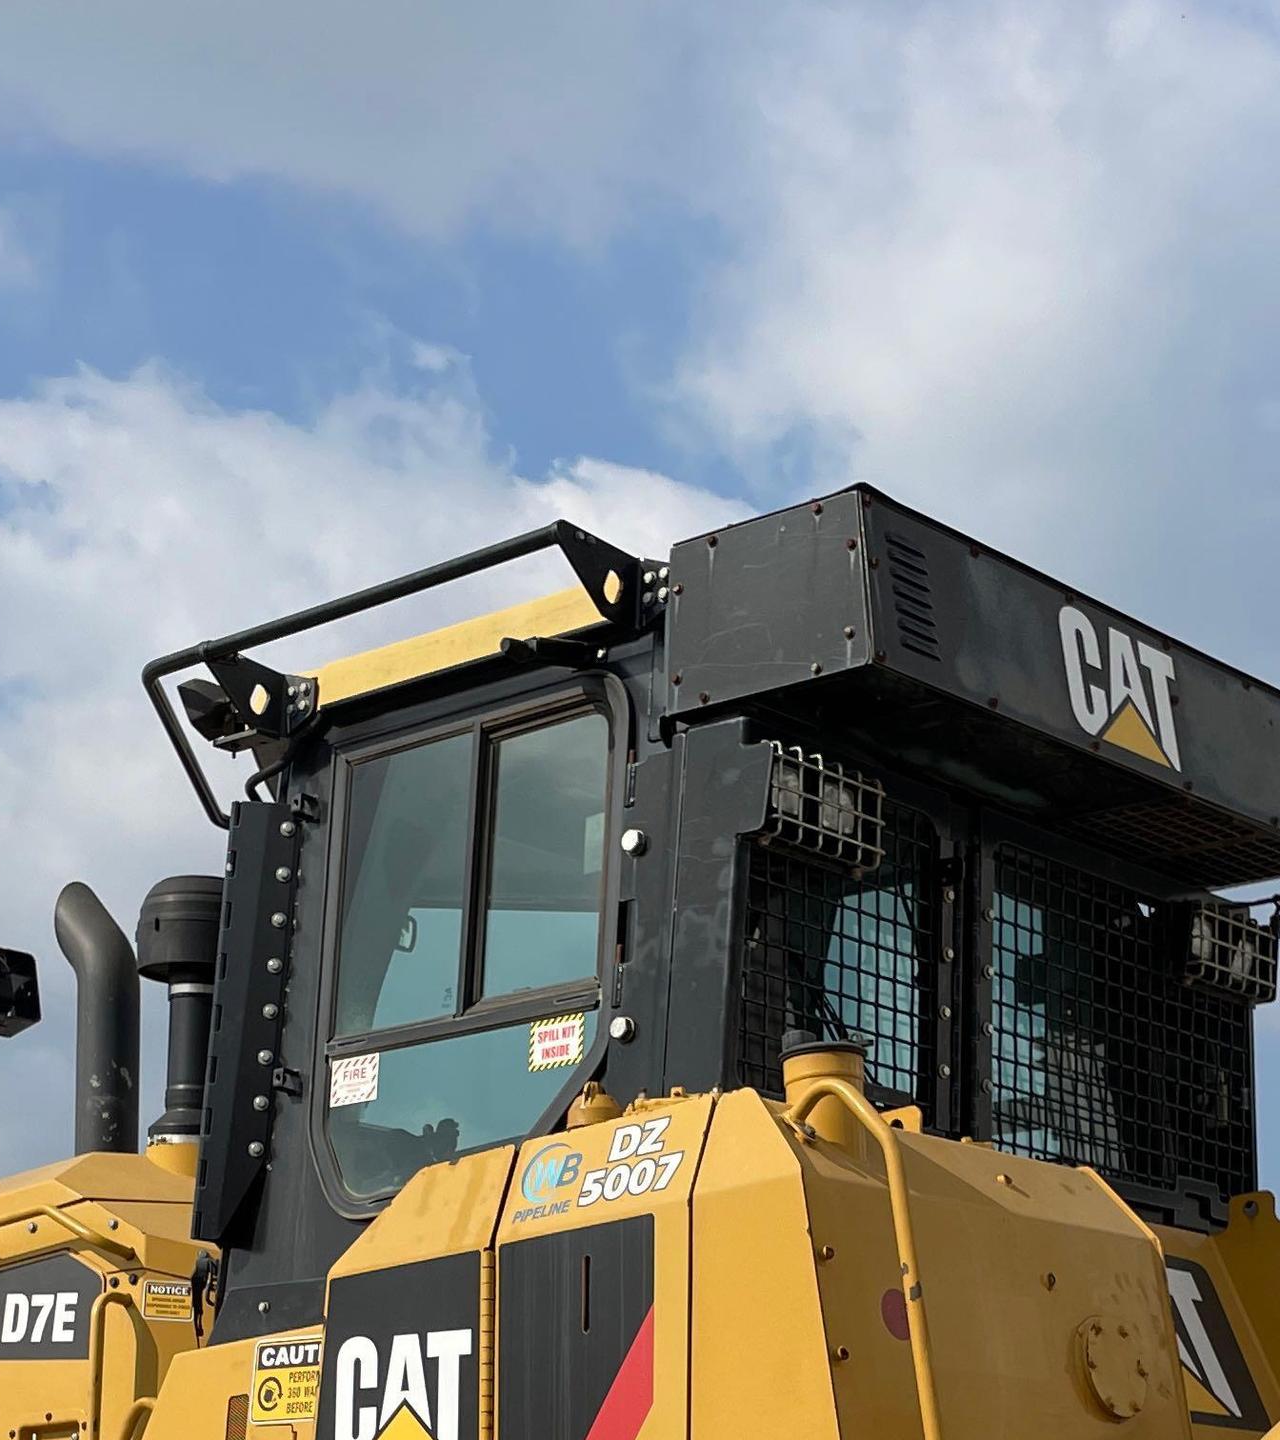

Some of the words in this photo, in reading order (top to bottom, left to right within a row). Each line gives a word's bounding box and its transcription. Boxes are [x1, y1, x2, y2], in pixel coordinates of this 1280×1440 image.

[1058, 605, 1182, 773] CAT
[537, 1028, 559, 1044] SPILL
[562, 1025, 576, 1038] KIT
[542, 1044, 570, 1060] INSIDE
[343, 1067, 368, 1081] FIRE
[607, 1115, 672, 1164] DZ
[577, 1150, 686, 1208] 5007
[511, 1200, 572, 1224] PIPELINE
[150, 1285, 189, 1296] NOTICE
[1, 1292, 79, 1343] D7E
[286, 1401, 313, 1414] BEFORE
